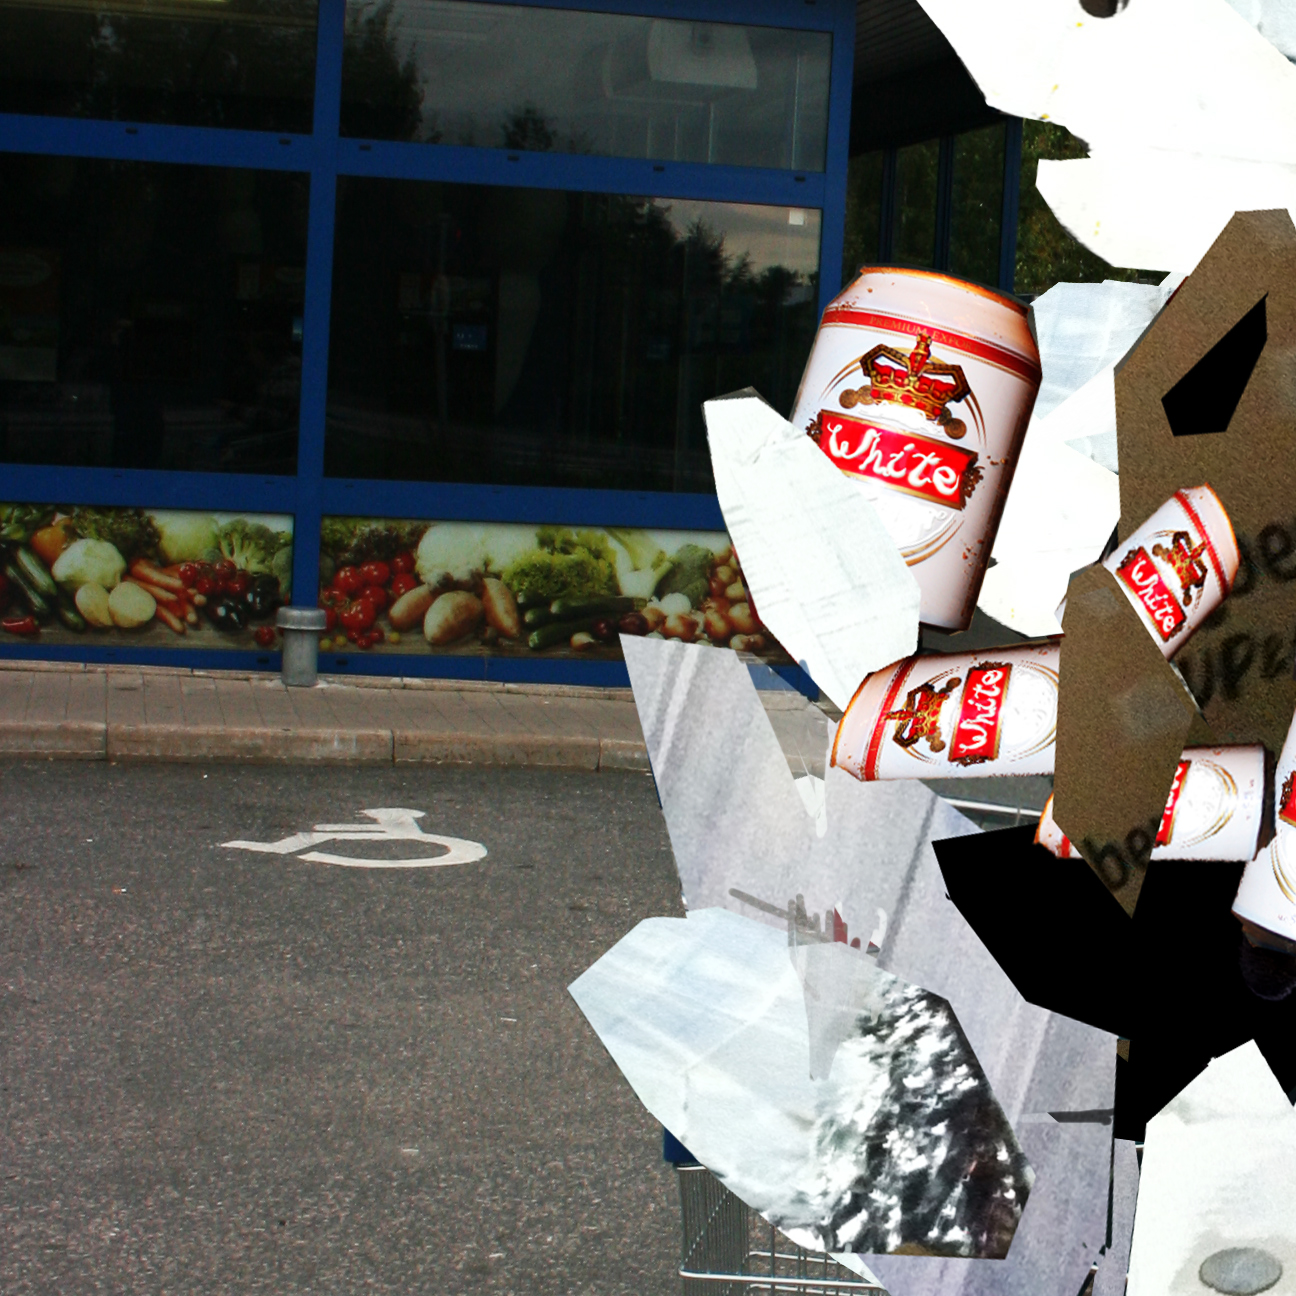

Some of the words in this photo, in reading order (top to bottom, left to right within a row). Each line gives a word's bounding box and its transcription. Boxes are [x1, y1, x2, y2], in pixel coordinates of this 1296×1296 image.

[868, 315, 928, 336] PREMIUM
[931, 330, 980, 353] EXPORT
[826, 421, 960, 496] White
[1130, 557, 1176, 633] White
[958, 669, 1004, 754] White
